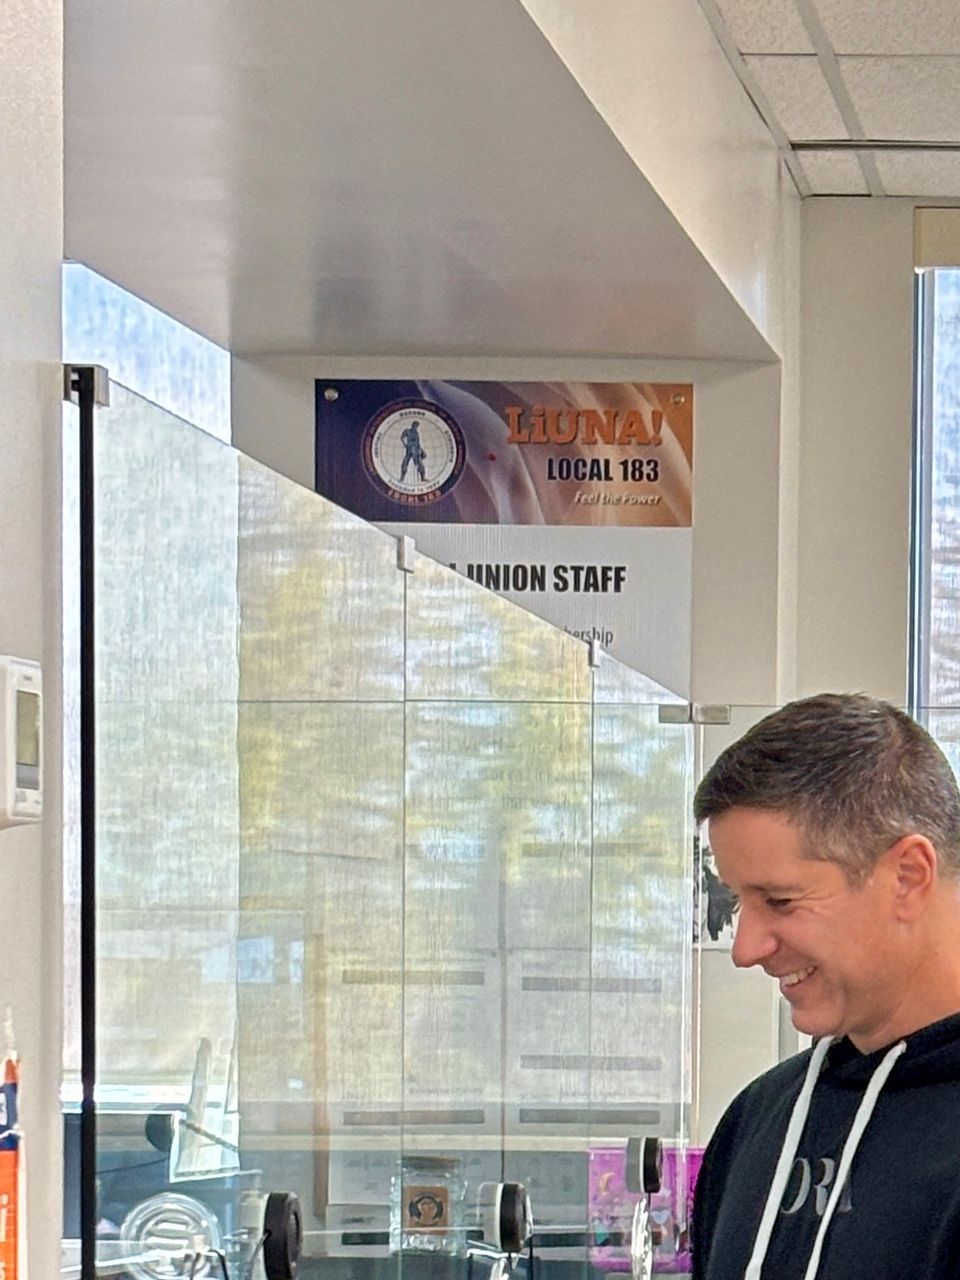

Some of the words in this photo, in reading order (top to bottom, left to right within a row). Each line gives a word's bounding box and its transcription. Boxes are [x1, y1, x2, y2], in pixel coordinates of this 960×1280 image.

[505, 405, 664, 446] LiUNA!
[547, 457, 614, 481] LOCAL
[619, 458, 659, 482] 183
[574, 491, 601, 505] Feel
[602, 491, 620, 505] the
[622, 492, 661, 505] Power
[466, 563, 546, 592] UNION
[553, 564, 626, 593] STAFF
